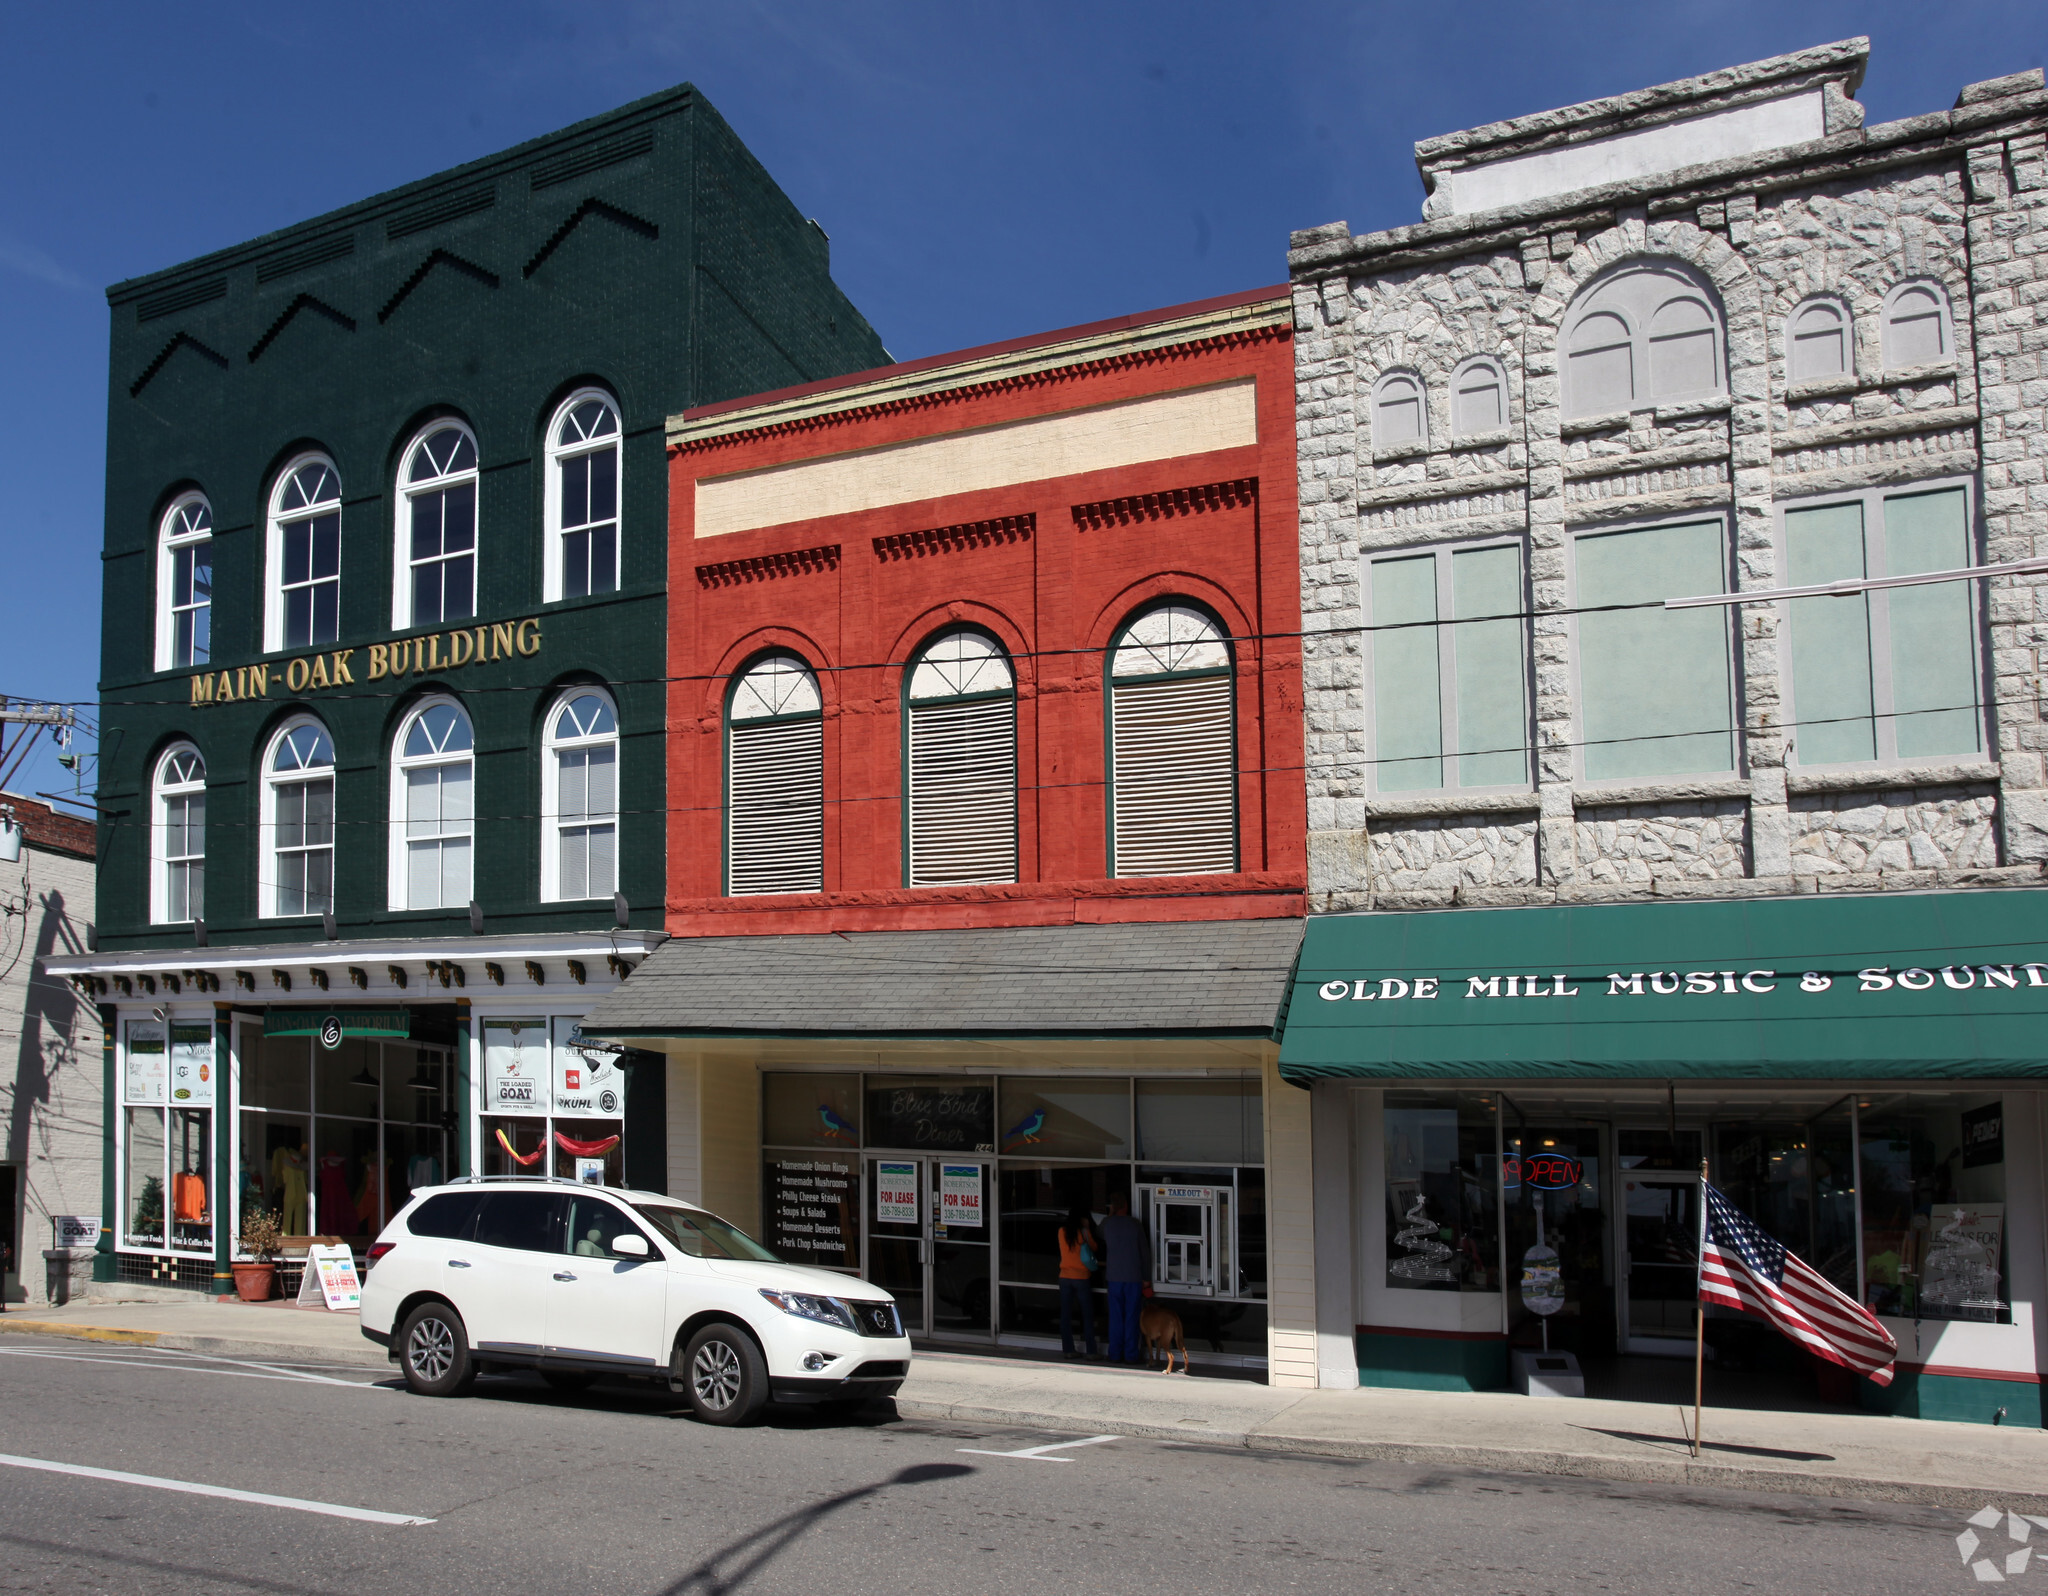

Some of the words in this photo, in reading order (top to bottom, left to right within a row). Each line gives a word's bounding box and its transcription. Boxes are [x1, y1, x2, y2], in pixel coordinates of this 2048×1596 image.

[190, 649, 354, 708] MAIN-OAK
[368, 618, 542, 680] BUILDING
[1317, 976, 1440, 1001] OLDE
[1462, 973, 1580, 998] MILL
[1604, 969, 1779, 995] MUSIC
[1799, 970, 1833, 993] &
[344, 1016, 406, 1031] EMPORIUM
[176, 1066, 189, 1077] UGG
[500, 1088, 532, 1100] GOAT
[563, 1096, 593, 1108] KÜHL
[892, 1090, 932, 1114] Blue
[915, 1118, 965, 1143] Diner
[782, 1160, 813, 1171] Homemade
[815, 1161, 831, 1172] Onion
[833, 1162, 848, 1175] Rings
[782, 1175, 813, 1186] Homemade
[815, 1177, 848, 1188] Mushrooms
[782, 1190, 798, 1203] Philly
[799, 1192, 819, 1202] Cheese
[821, 1193, 841, 1204] Steaks
[880, 1191, 893, 1203] FOR
[895, 1192, 914, 1204] LEASE
[1187, 1189, 1201, 1197] OUT
[944, 1193, 958, 1207] FOR
[961, 1194, 979, 1207] SALE
[782, 1206, 799, 1218] Soups
[801, 1207, 805, 1216] &
[807, 1207, 826, 1218] Salads
[63, 1227, 95, 1235] GOAT
[782, 1221, 813, 1233] Homemade
[815, 1223, 841, 1234] Desserts
[149, 1234, 163, 1243] Foods
[170, 1236, 183, 1245] Wine
[188, 1238, 203, 1246] Coffee
[782, 1237, 796, 1248] Pork
[797, 1238, 811, 1251] Chop
[812, 1239, 846, 1251] Sandwiches
[1976, 1232, 1998, 1245] FOR
